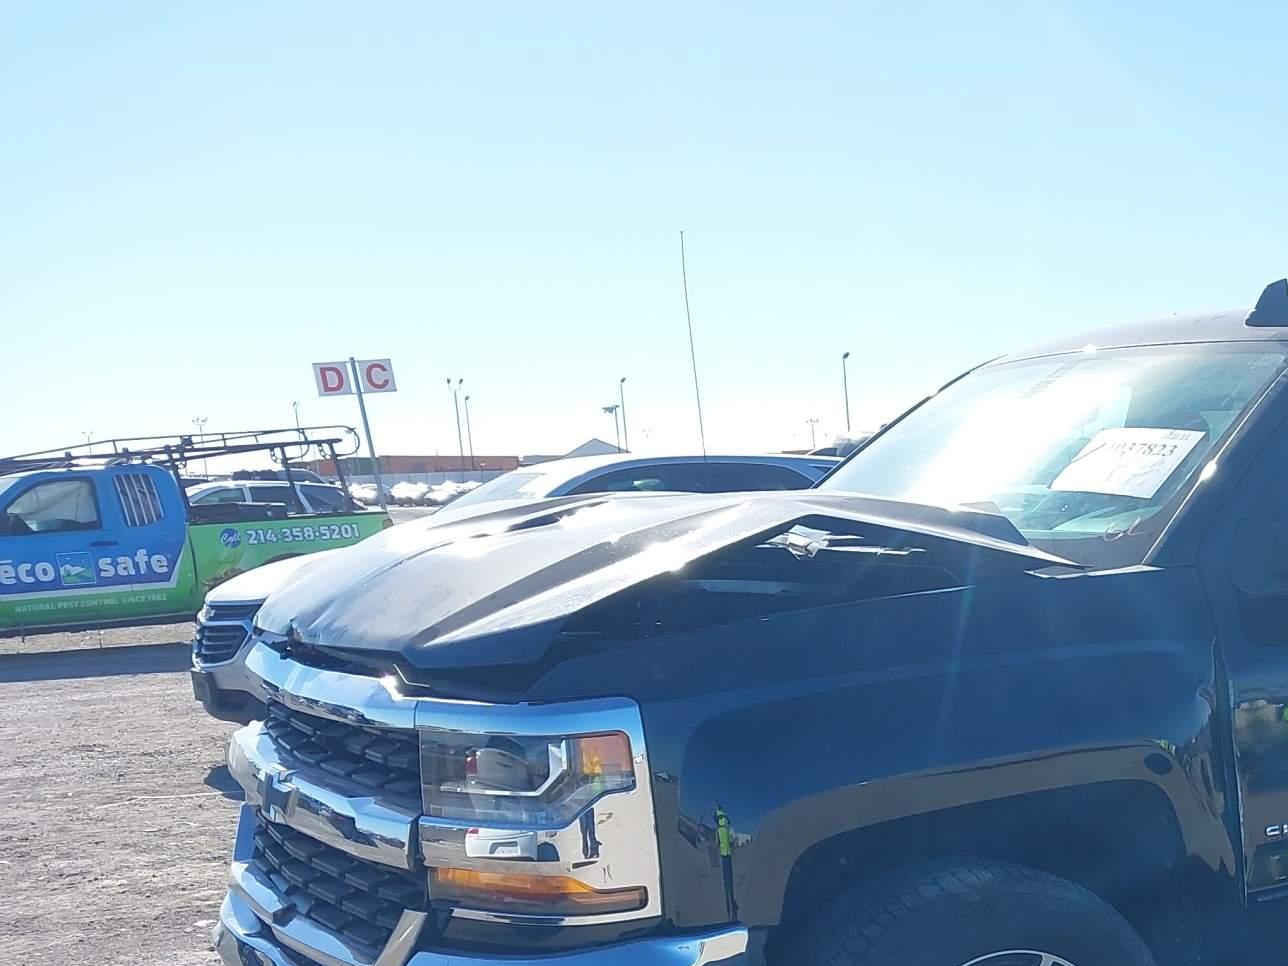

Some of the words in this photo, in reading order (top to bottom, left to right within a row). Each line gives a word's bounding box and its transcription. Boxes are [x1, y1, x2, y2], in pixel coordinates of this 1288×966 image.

[319, 366, 344, 392] D
[366, 363, 389, 389] C
[98, 549, 168, 578] safe
[15, 603, 57, 613] NATURAL
[57, 600, 80, 610] PEST
[80, 598, 120, 608] CONTROL
[122, 595, 146, 604] SINCE
